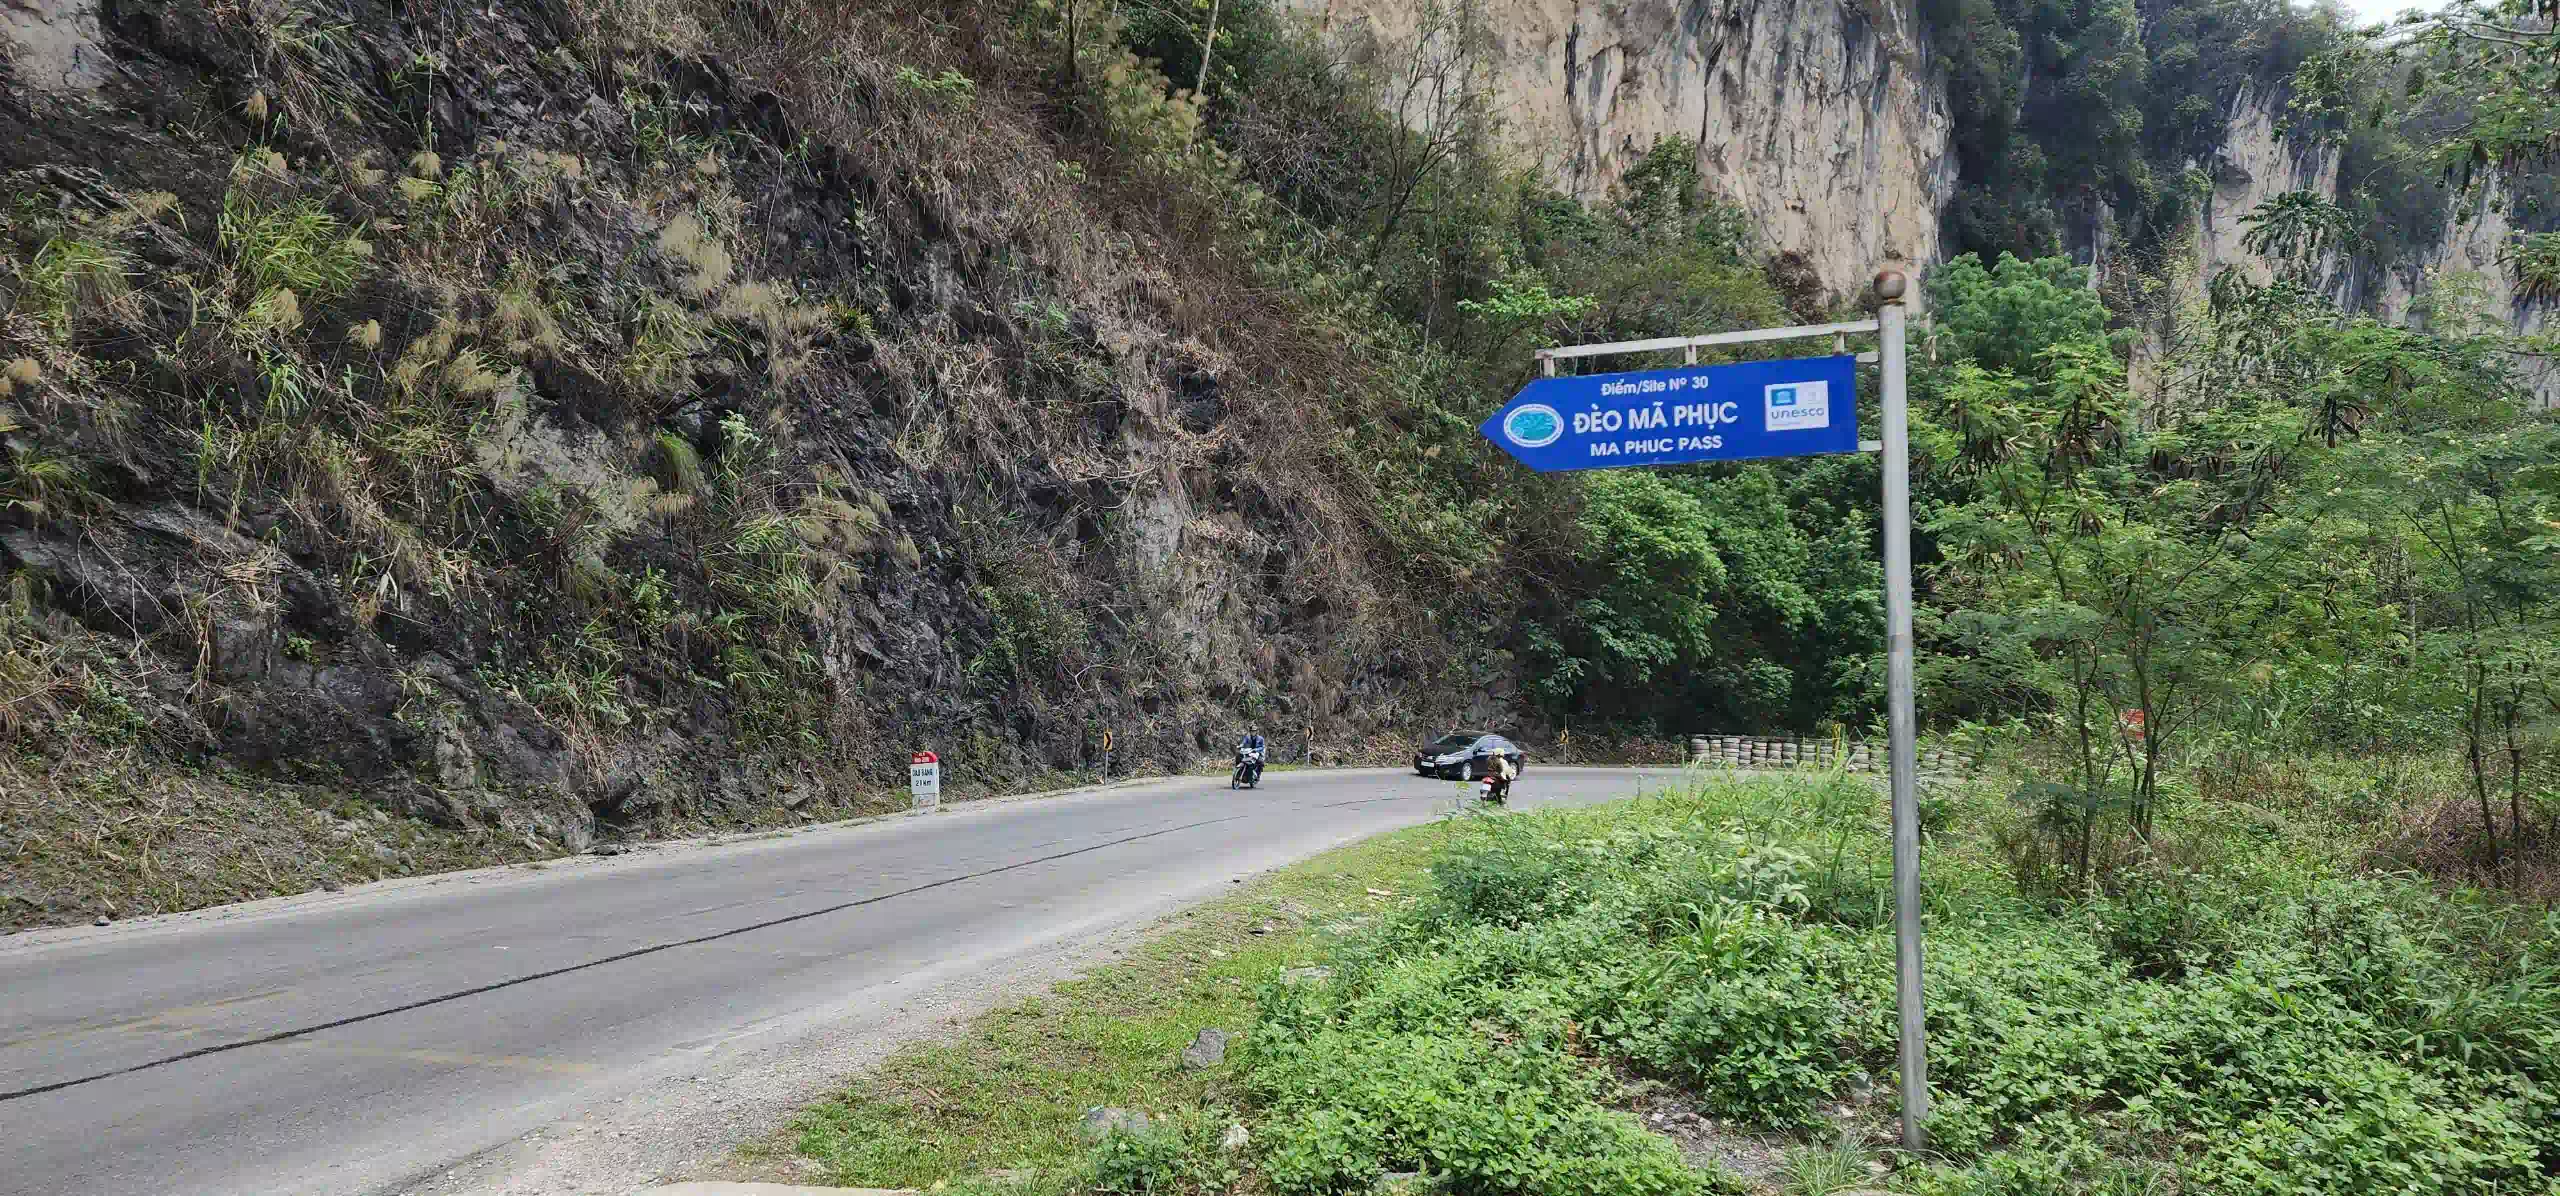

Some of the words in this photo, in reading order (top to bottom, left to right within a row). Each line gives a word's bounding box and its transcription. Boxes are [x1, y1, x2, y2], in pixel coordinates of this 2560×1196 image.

[1691, 375, 1709, 389] 30
[1573, 403, 1622, 434] ĐÈO
[1628, 401, 1668, 430] MÃ
[1674, 401, 1738, 430] PHỤC
[1771, 408, 1825, 420] unesco
[1590, 442, 1620, 457] MA
[1625, 438, 1674, 454] PHUC
[1678, 435, 1723, 451] PASS
